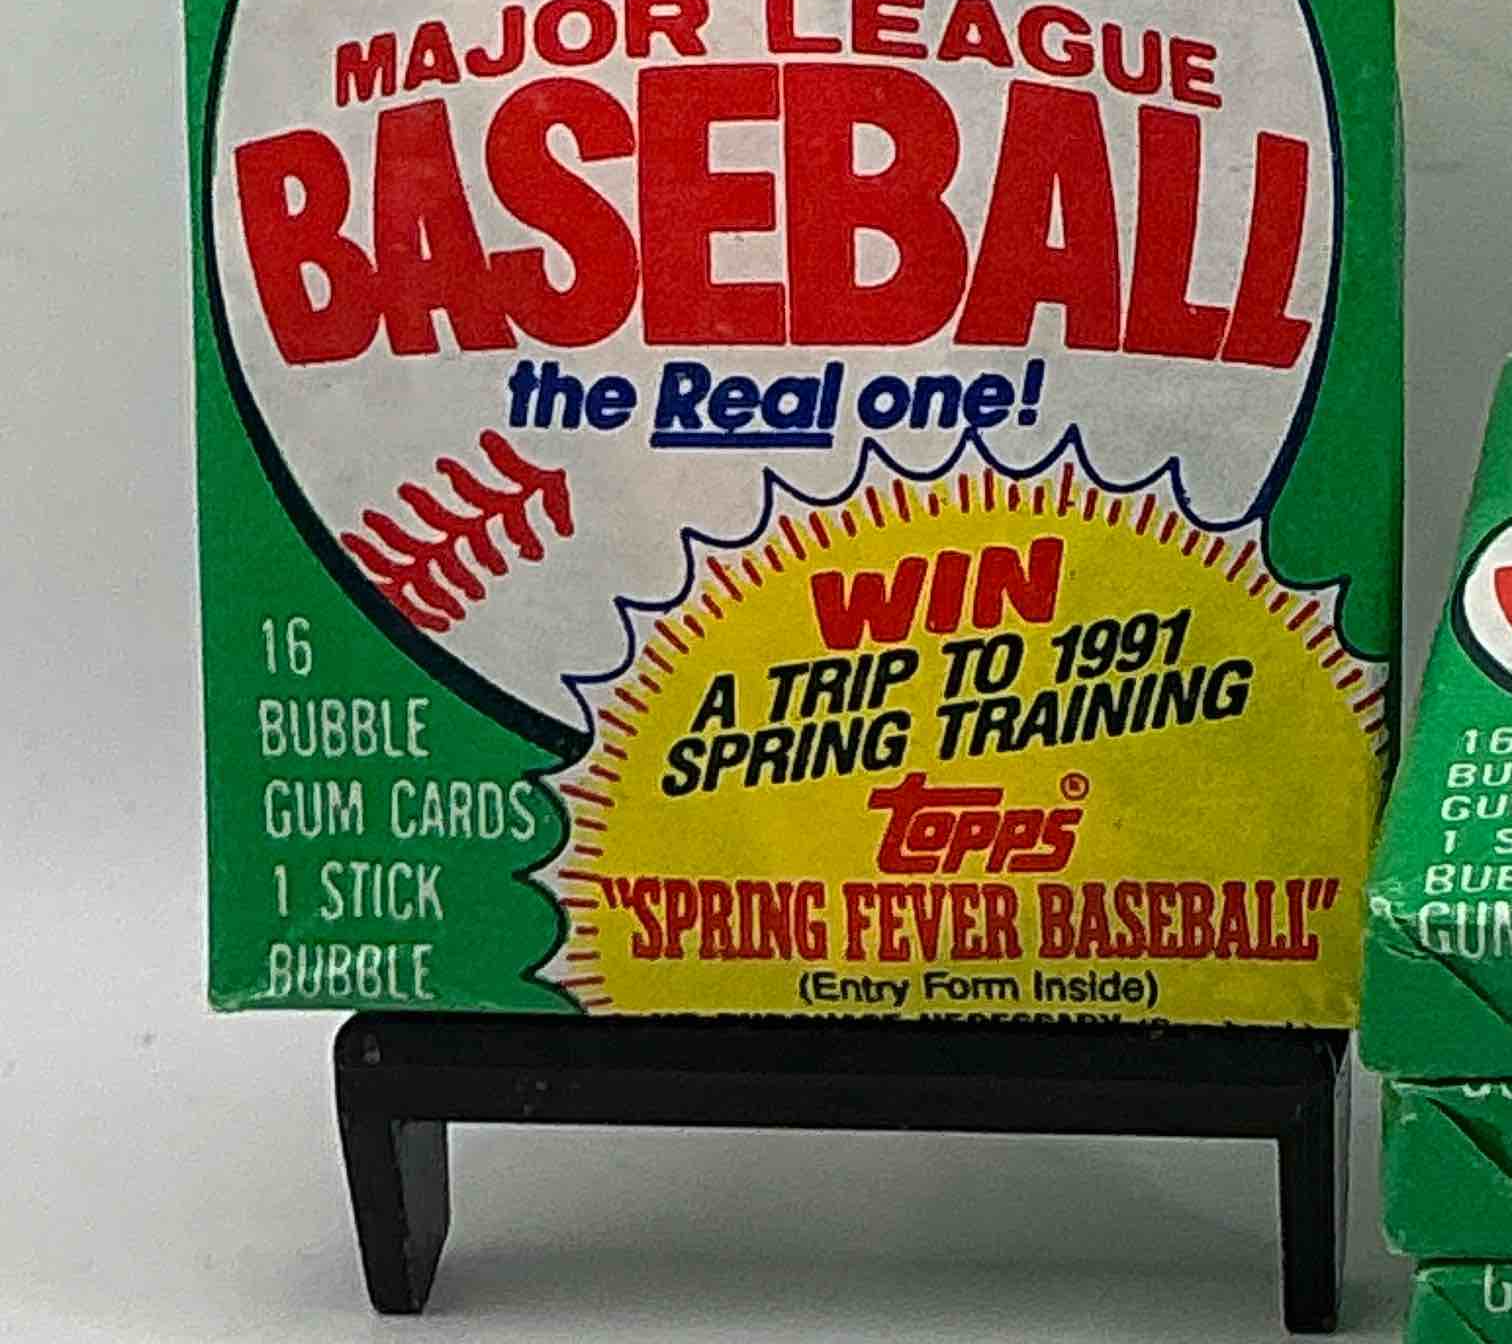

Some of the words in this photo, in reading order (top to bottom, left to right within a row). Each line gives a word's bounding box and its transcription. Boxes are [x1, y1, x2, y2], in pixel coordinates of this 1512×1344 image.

[234, 62, 1310, 368] BASEBALL
[508, 362, 634, 430] the
[651, 361, 843, 448] Real
[858, 358, 1046, 431] one!
[810, 536, 1066, 651] WIN
[262, 616, 313, 677] 16
[690, 674, 738, 734] A
[768, 648, 918, 720] TRIP
[942, 632, 1024, 698] TO
[1050, 608, 1192, 682] 1991
[258, 697, 430, 758] BUBBLE
[660, 711, 912, 796] SPRING
[934, 658, 1254, 762] TRAINING
[264, 779, 365, 840] GUM
[391, 779, 536, 841] CARDS
[1443, 829, 1459, 855] 1
[274, 864, 289, 918] 1
[320, 860, 444, 920] STICK
[844, 881, 1020, 961] FEVER
[266, 942, 435, 1001] BUBBLE
[799, 971, 909, 1006] (Entry
[924, 973, 1021, 1003] Form
[1033, 971, 1159, 1007] Inside)
